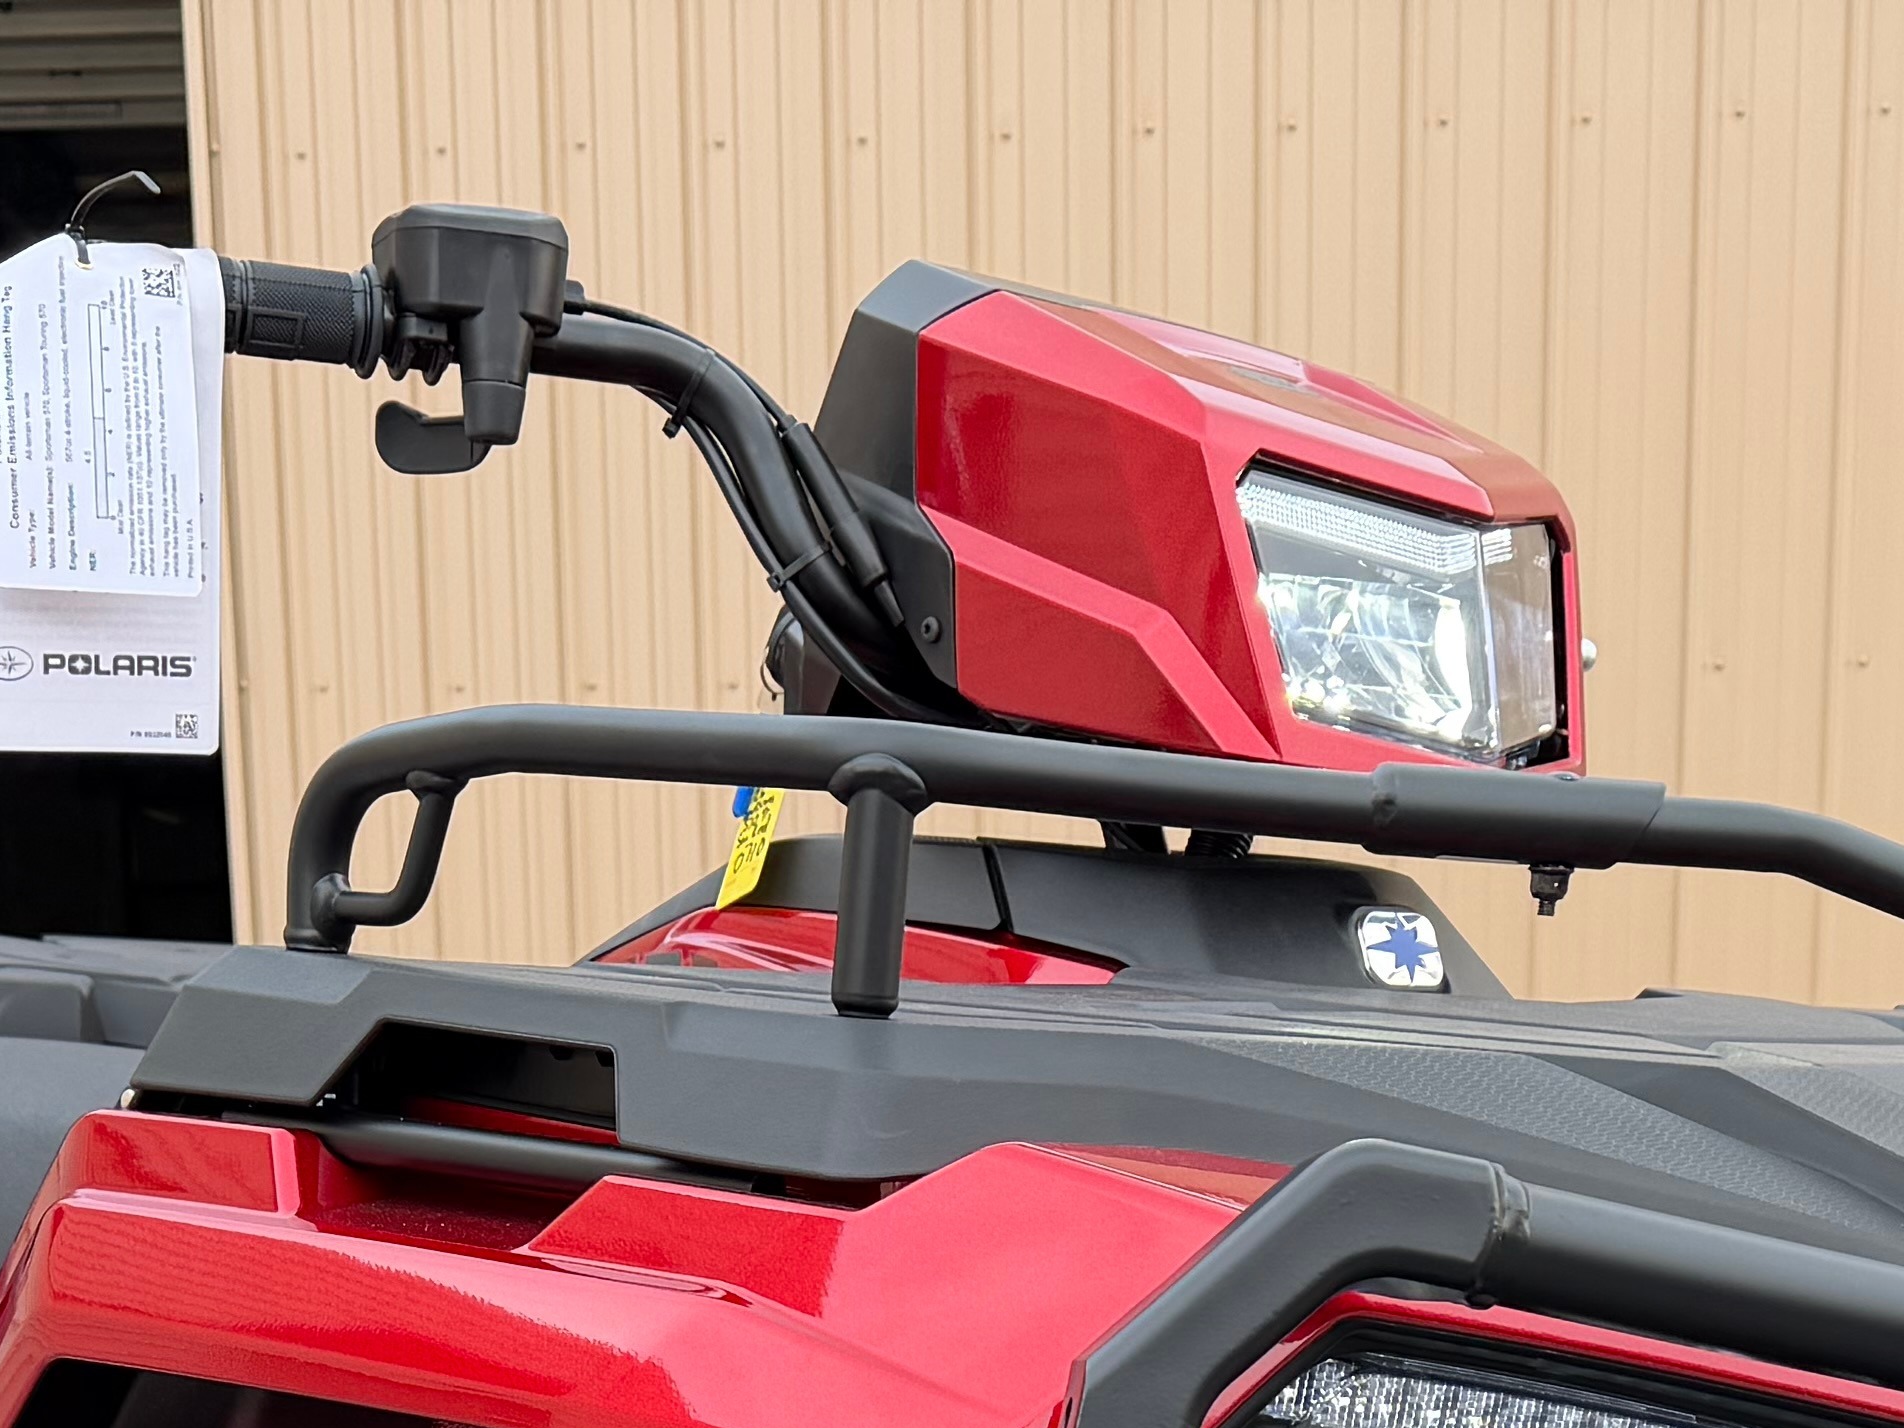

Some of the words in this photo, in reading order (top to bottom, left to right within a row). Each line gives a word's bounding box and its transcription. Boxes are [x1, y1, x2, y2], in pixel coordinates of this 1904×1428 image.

[1, 286, 12, 303] Tag
[2, 306, 12, 333] Hang
[4, 338, 14, 400] Information
[7, 405, 17, 463] Emissions
[10, 468, 19, 528] Consumer
[43, 653, 192, 678] POLARIS
